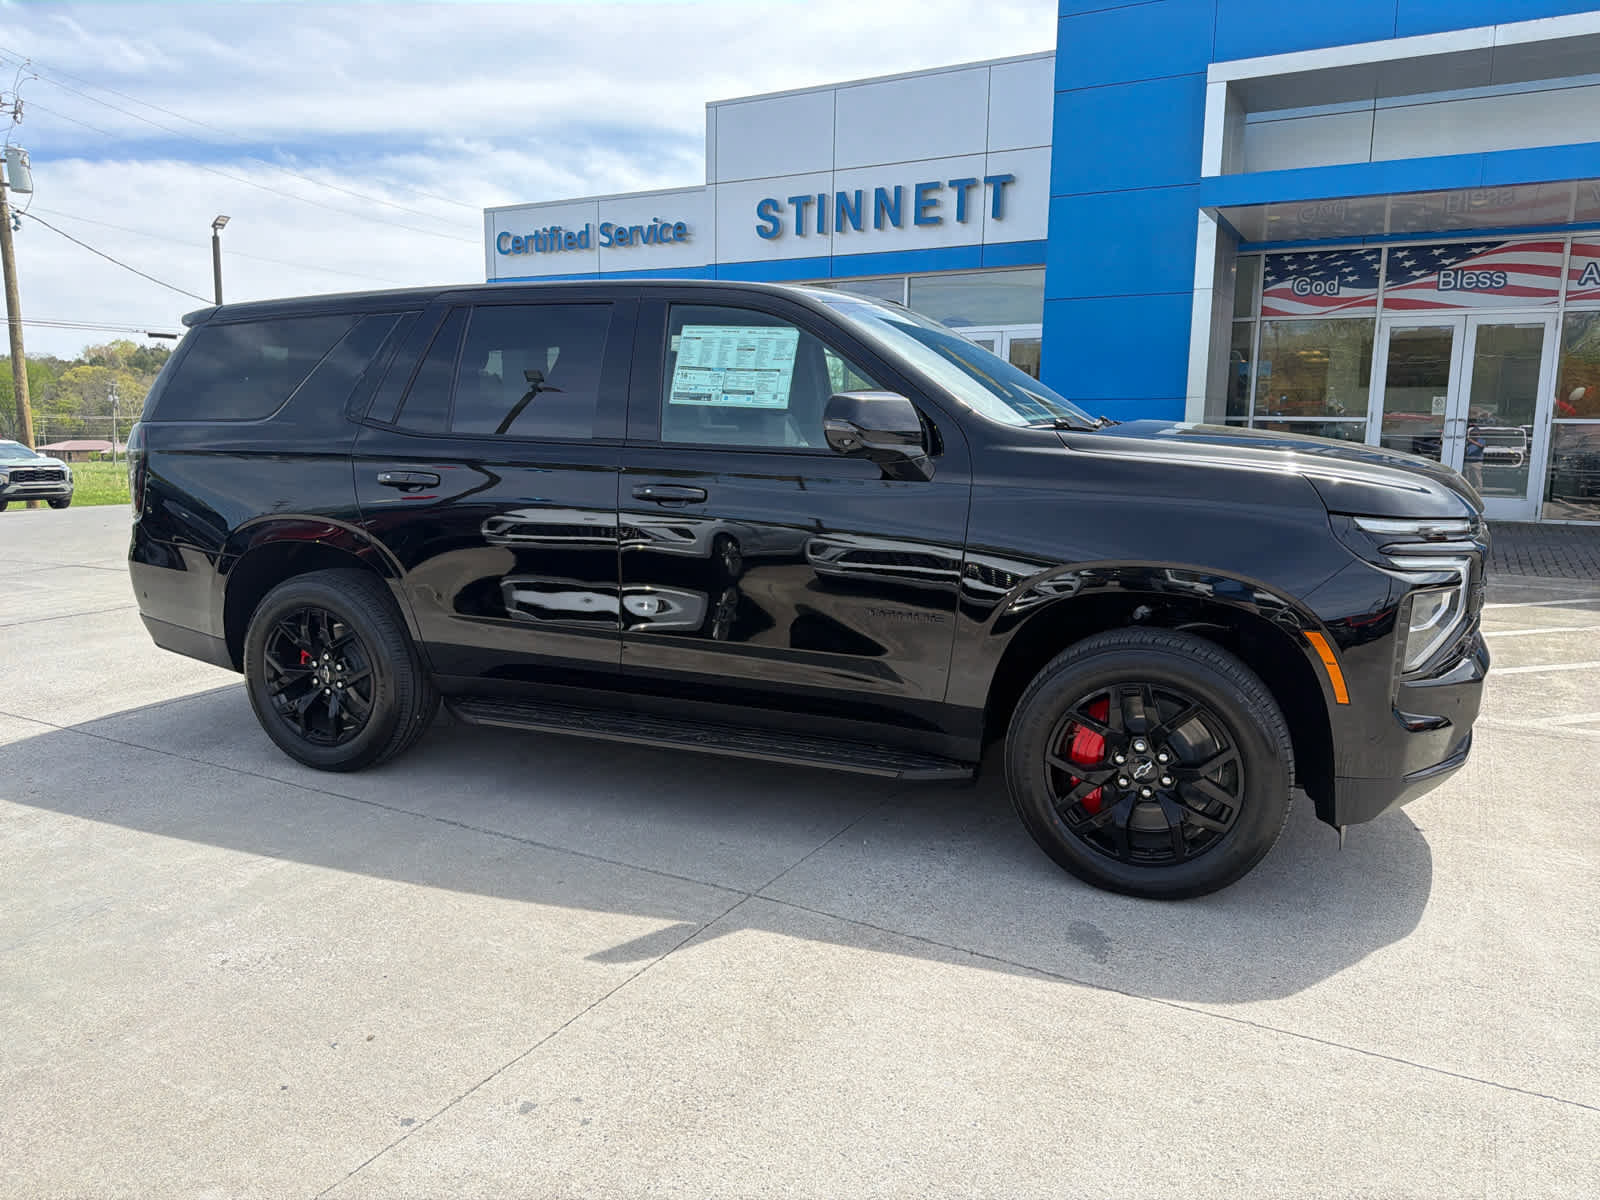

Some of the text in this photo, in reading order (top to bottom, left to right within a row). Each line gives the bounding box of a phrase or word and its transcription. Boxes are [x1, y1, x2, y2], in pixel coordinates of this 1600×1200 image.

[756, 174, 1015, 240] STINNETT
[496, 217, 688, 255] Certified Service
[1292, 275, 1340, 296] God
[1437, 269, 1507, 291] Bless
